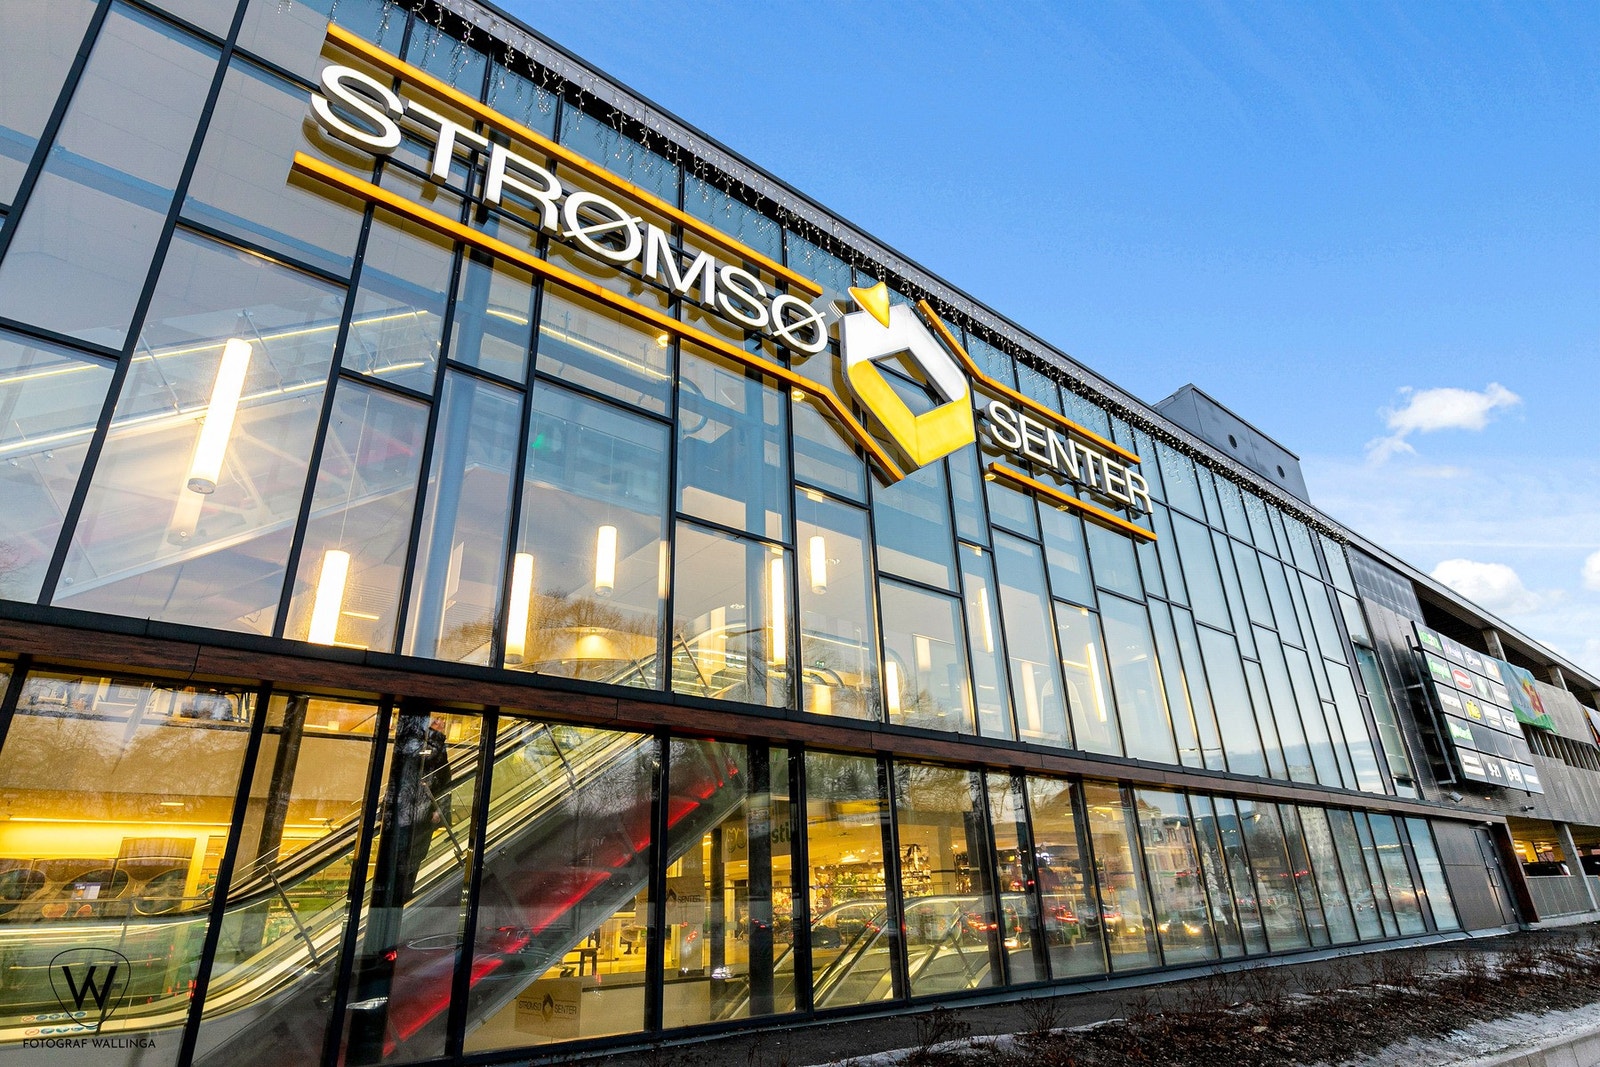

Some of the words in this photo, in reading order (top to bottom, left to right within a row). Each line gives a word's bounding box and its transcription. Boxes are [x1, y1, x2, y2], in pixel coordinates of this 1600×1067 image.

[310, 64, 828, 357] STRØMSØ
[986, 400, 1153, 515] SENTER
[554, 1003, 577, 1015] SENTER
